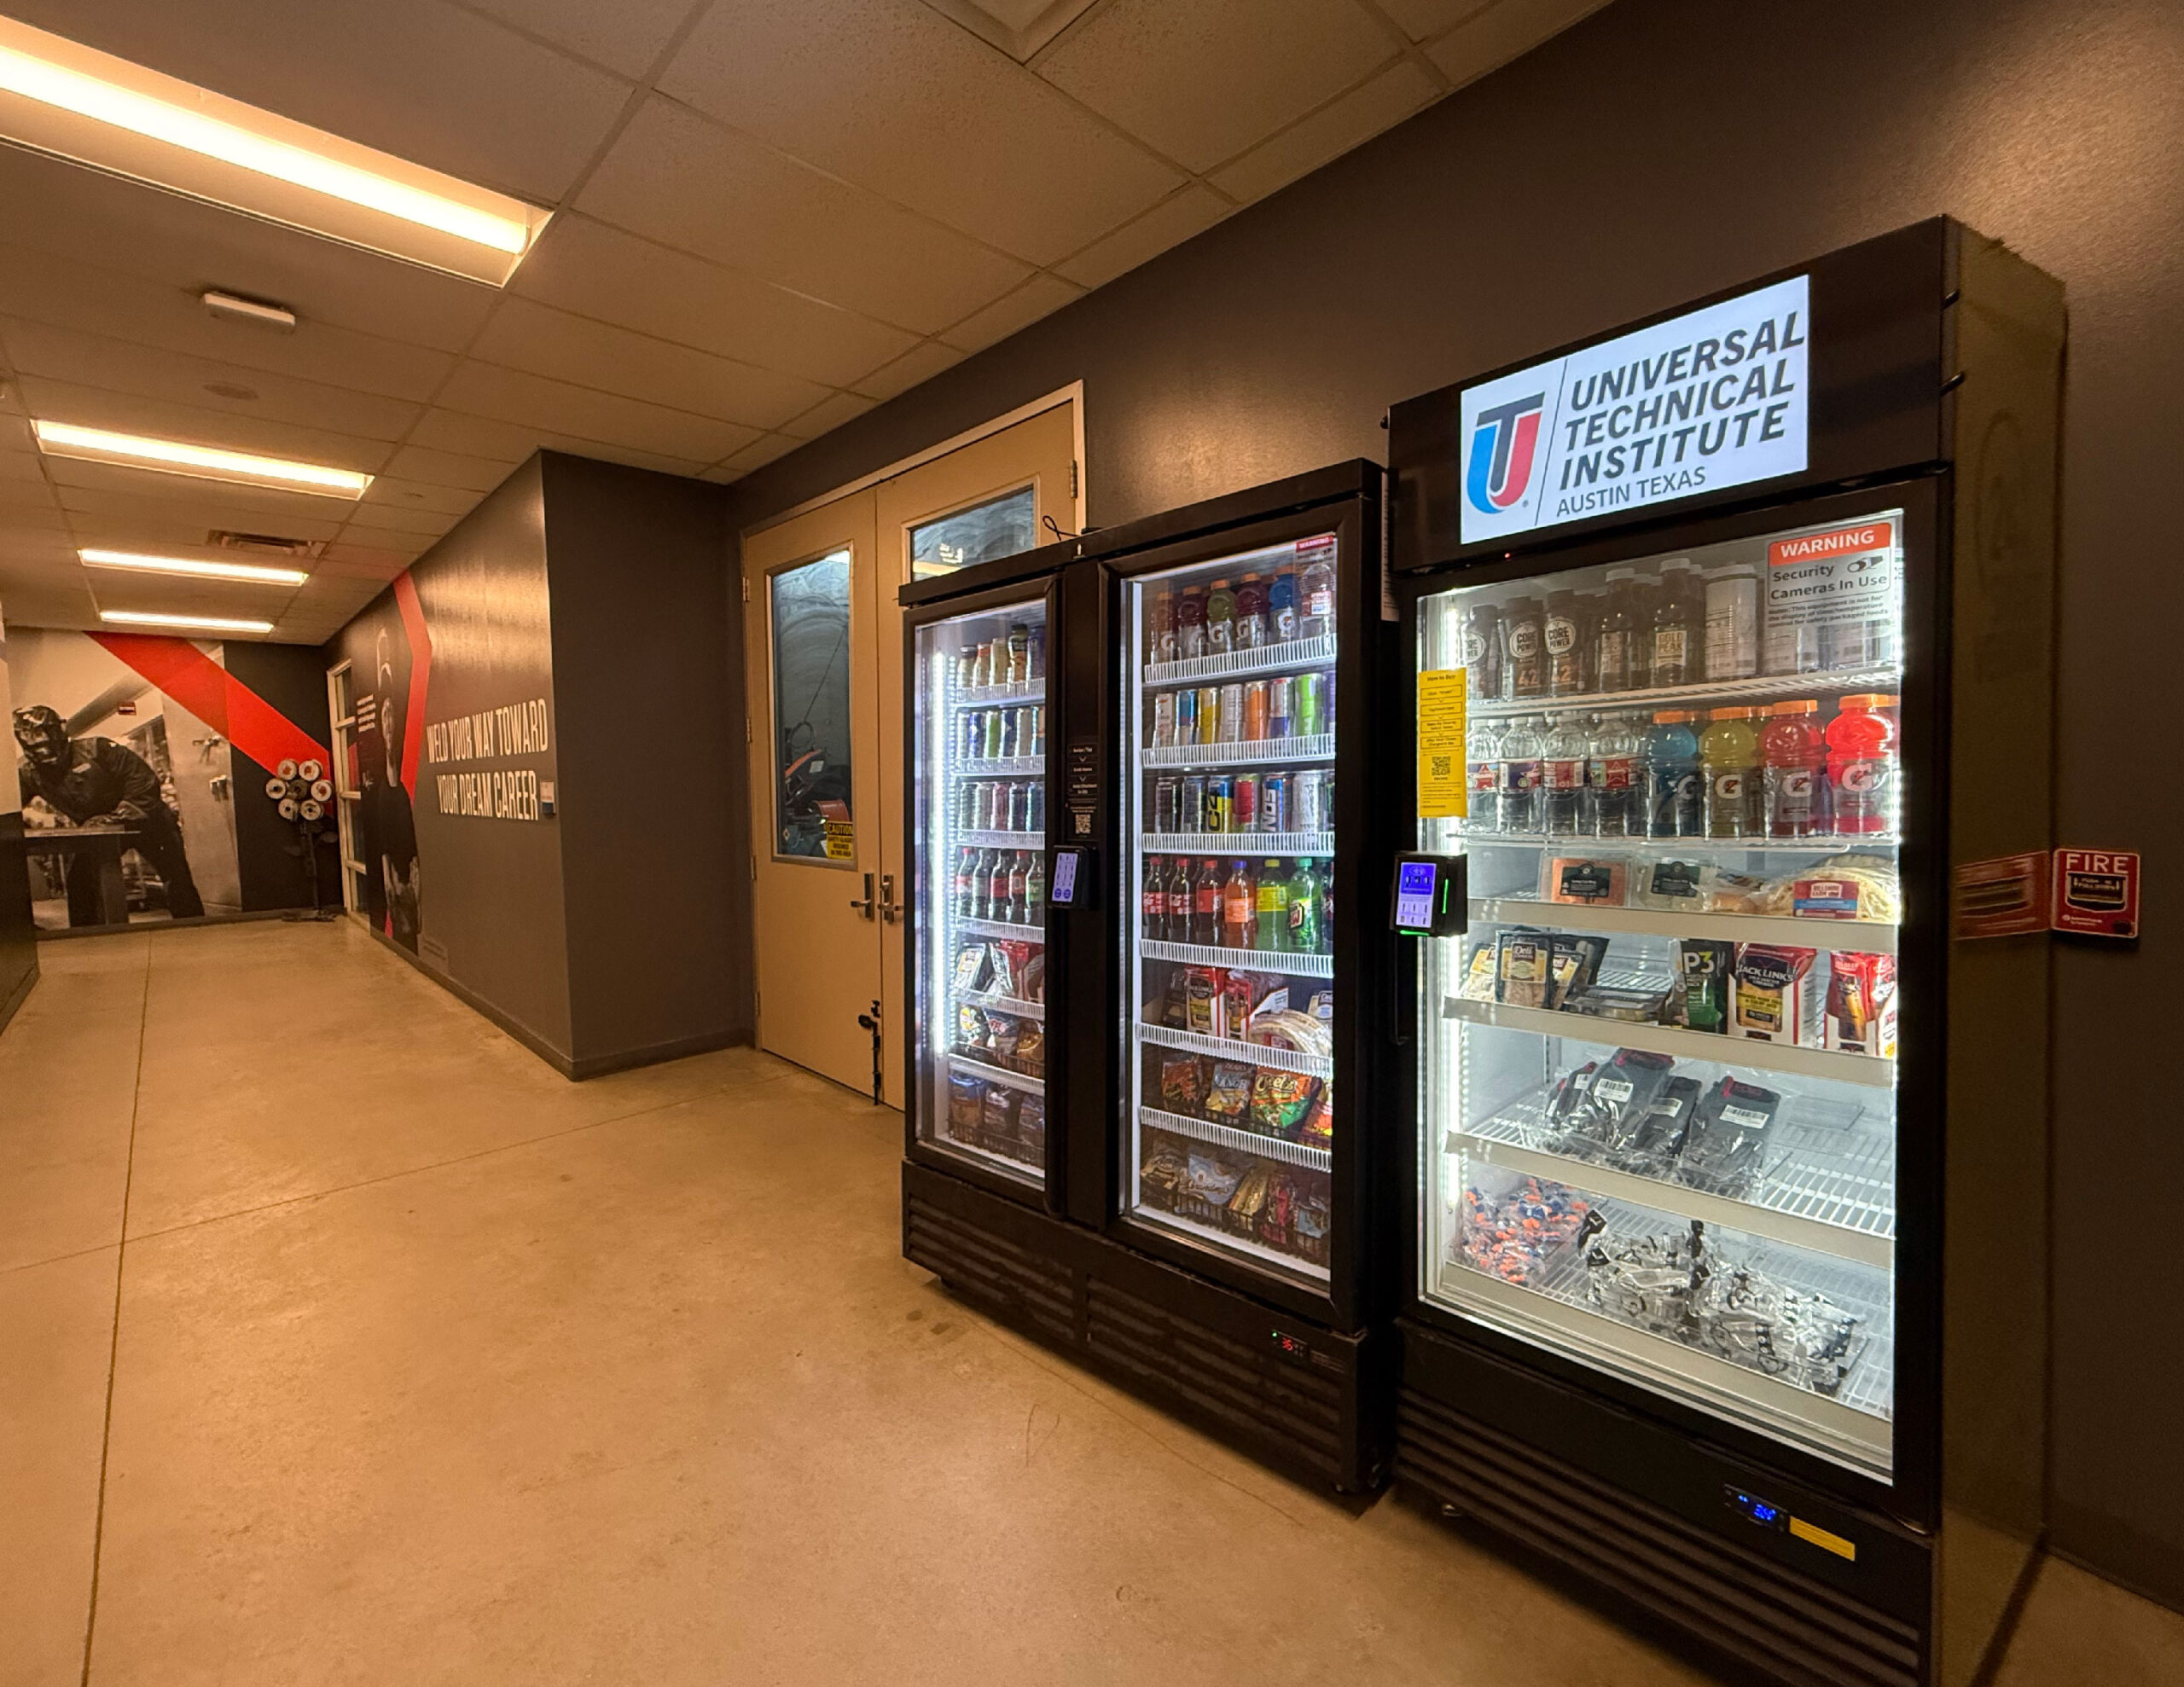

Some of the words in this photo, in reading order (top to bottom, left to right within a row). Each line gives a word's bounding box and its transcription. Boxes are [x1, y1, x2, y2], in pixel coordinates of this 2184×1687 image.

[1571, 310, 1805, 411] UNIVERSAL
[1565, 358, 1795, 452] TECHNICAL
[1560, 401, 1790, 491] INSTITUTE
[1556, 483, 1630, 518] AUSTIN
[1636, 466, 1706, 500] TEXAS
[1780, 530, 1875, 558] WARNING
[1770, 582, 1835, 600] Cameras
[1839, 578, 1854, 591] In
[1859, 575, 1887, 588] Use
[1773, 564, 1835, 583] Security
[1548, 626, 1570, 640] CORE
[1549, 638, 1571, 649] POWER
[427, 722, 448, 764] WELD
[448, 716, 473, 762] YOUR
[473, 710, 495, 759] WAY
[496, 699, 549, 757] TOWARD
[1715, 774, 1742, 799] G
[1782, 771, 1812, 798] G
[1842, 763, 1873, 792] G
[437, 774, 459, 815] YOUR
[459, 772, 493, 818] DREAM
[493, 770, 538, 821] CAREER
[1208, 790, 1221, 832] C4
[1263, 789, 1277, 832] NOS
[2066, 853, 2129, 874] FIRE
[1682, 951, 1715, 974] P3
[1737, 964, 1762, 977] JACK
